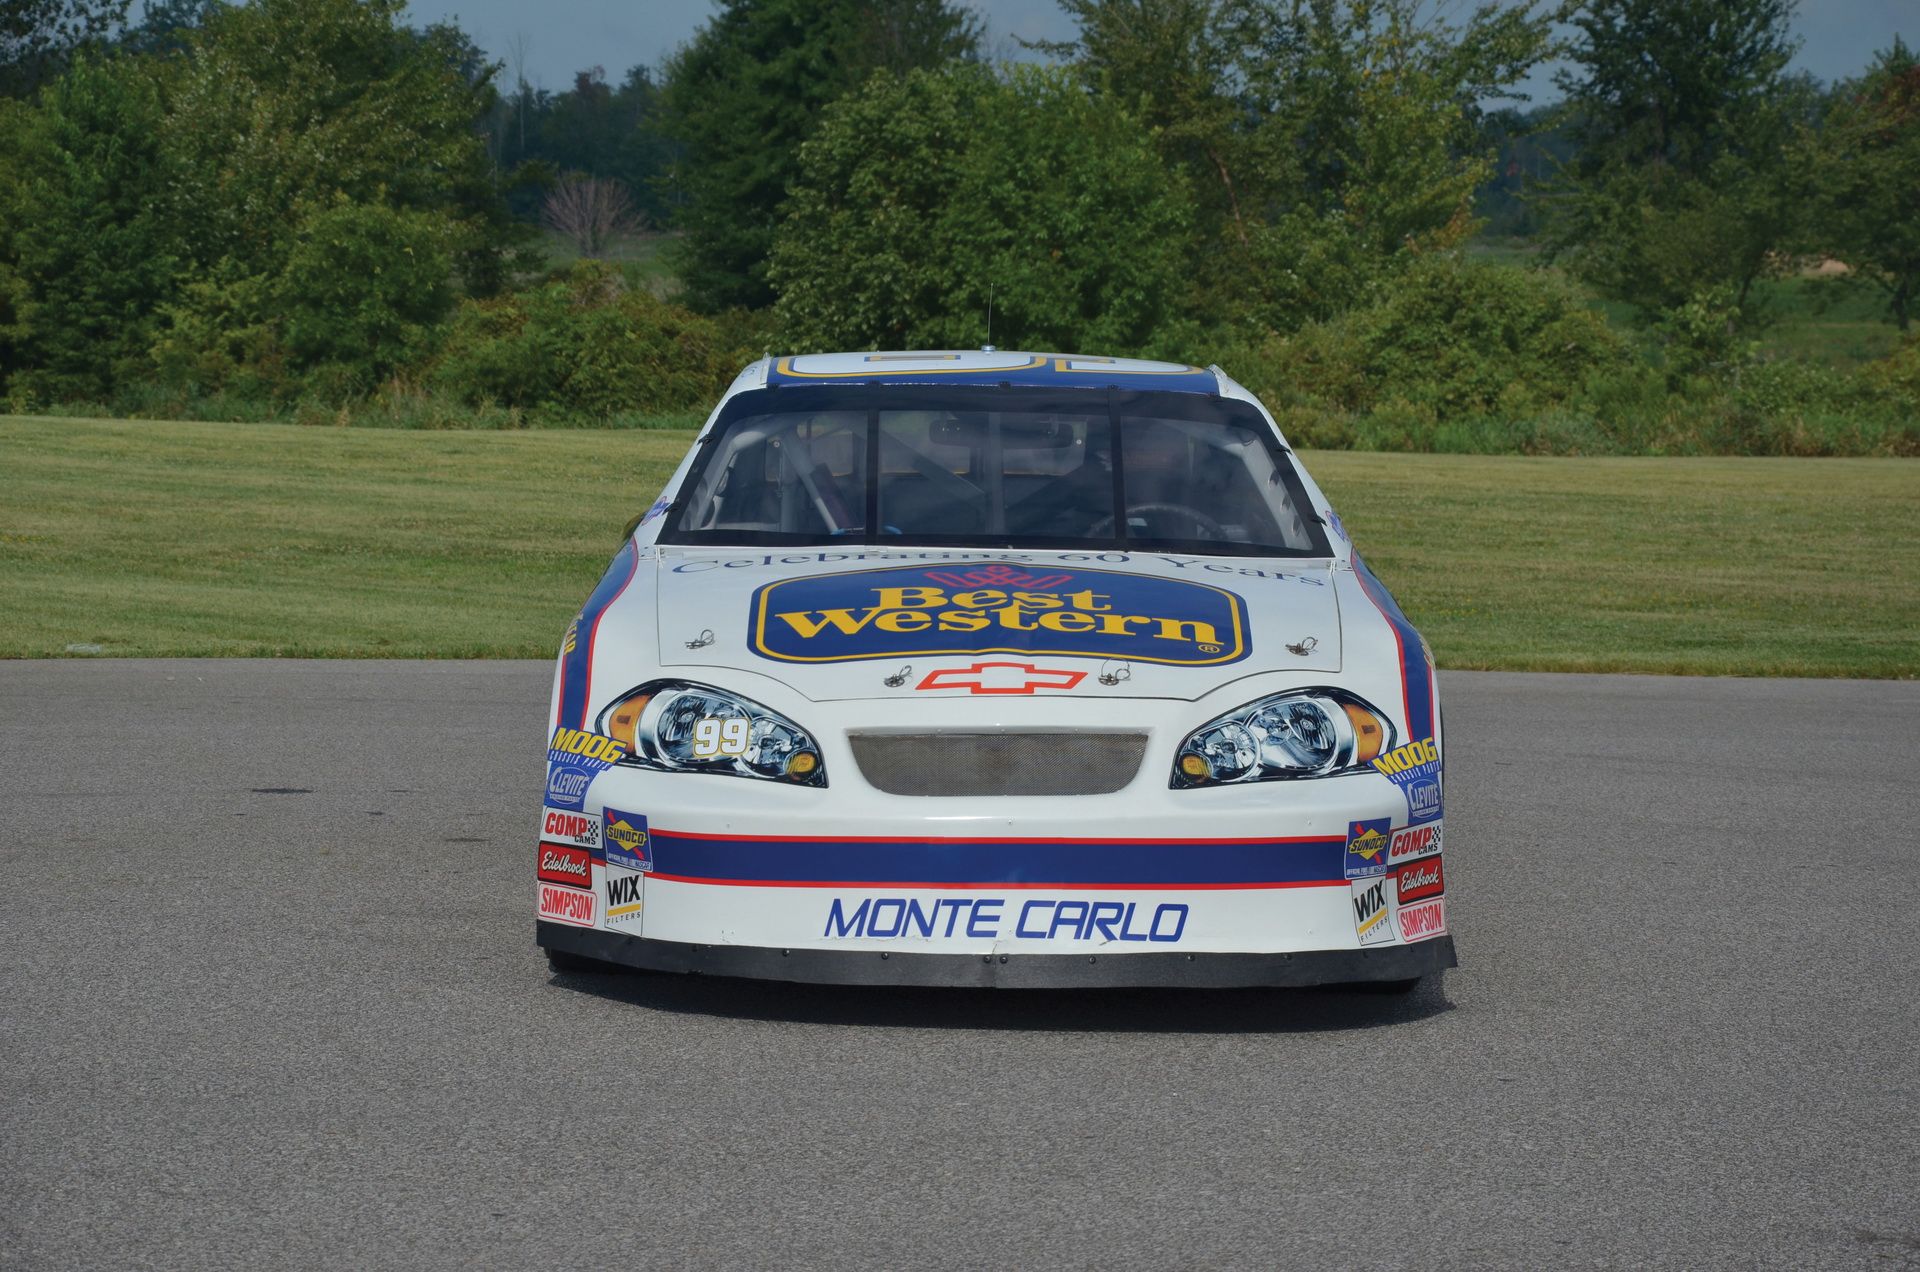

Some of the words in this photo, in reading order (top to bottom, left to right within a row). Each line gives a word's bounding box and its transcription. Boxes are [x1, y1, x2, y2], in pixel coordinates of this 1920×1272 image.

[672, 552, 1033, 573] Celebrating
[1057, 554, 1130, 563] 60
[1157, 556, 1325, 587] Years
[870, 586, 1112, 611] Best
[774, 602, 1225, 646] Western
[550, 727, 627, 764] MOOG
[694, 718, 749, 757] 99
[1371, 737, 1438, 777] MOOG
[550, 766, 590, 796] CLEVITE
[1407, 783, 1439, 811] CLEVITE
[545, 812, 587, 838] COMP
[574, 834, 597, 846] CAMS
[608, 826, 645, 845] SUNOCO
[1350, 836, 1386, 853] SUNOCO
[1391, 826, 1432, 857] COMP
[1418, 842, 1438, 855] CAMS
[542, 850, 587, 876] Edelbrock
[607, 875, 640, 906] WIX
[1401, 865, 1440, 892] Edelbrock
[541, 886, 593, 921] SIMPSON
[1354, 879, 1385, 922] WIX
[606, 911, 641, 925] FILTERS
[824, 898, 1005, 938] MONTE
[1015, 900, 1189, 942] CARLO
[1360, 917, 1388, 943] FILTERS
[1400, 903, 1442, 938] SIMPSON
